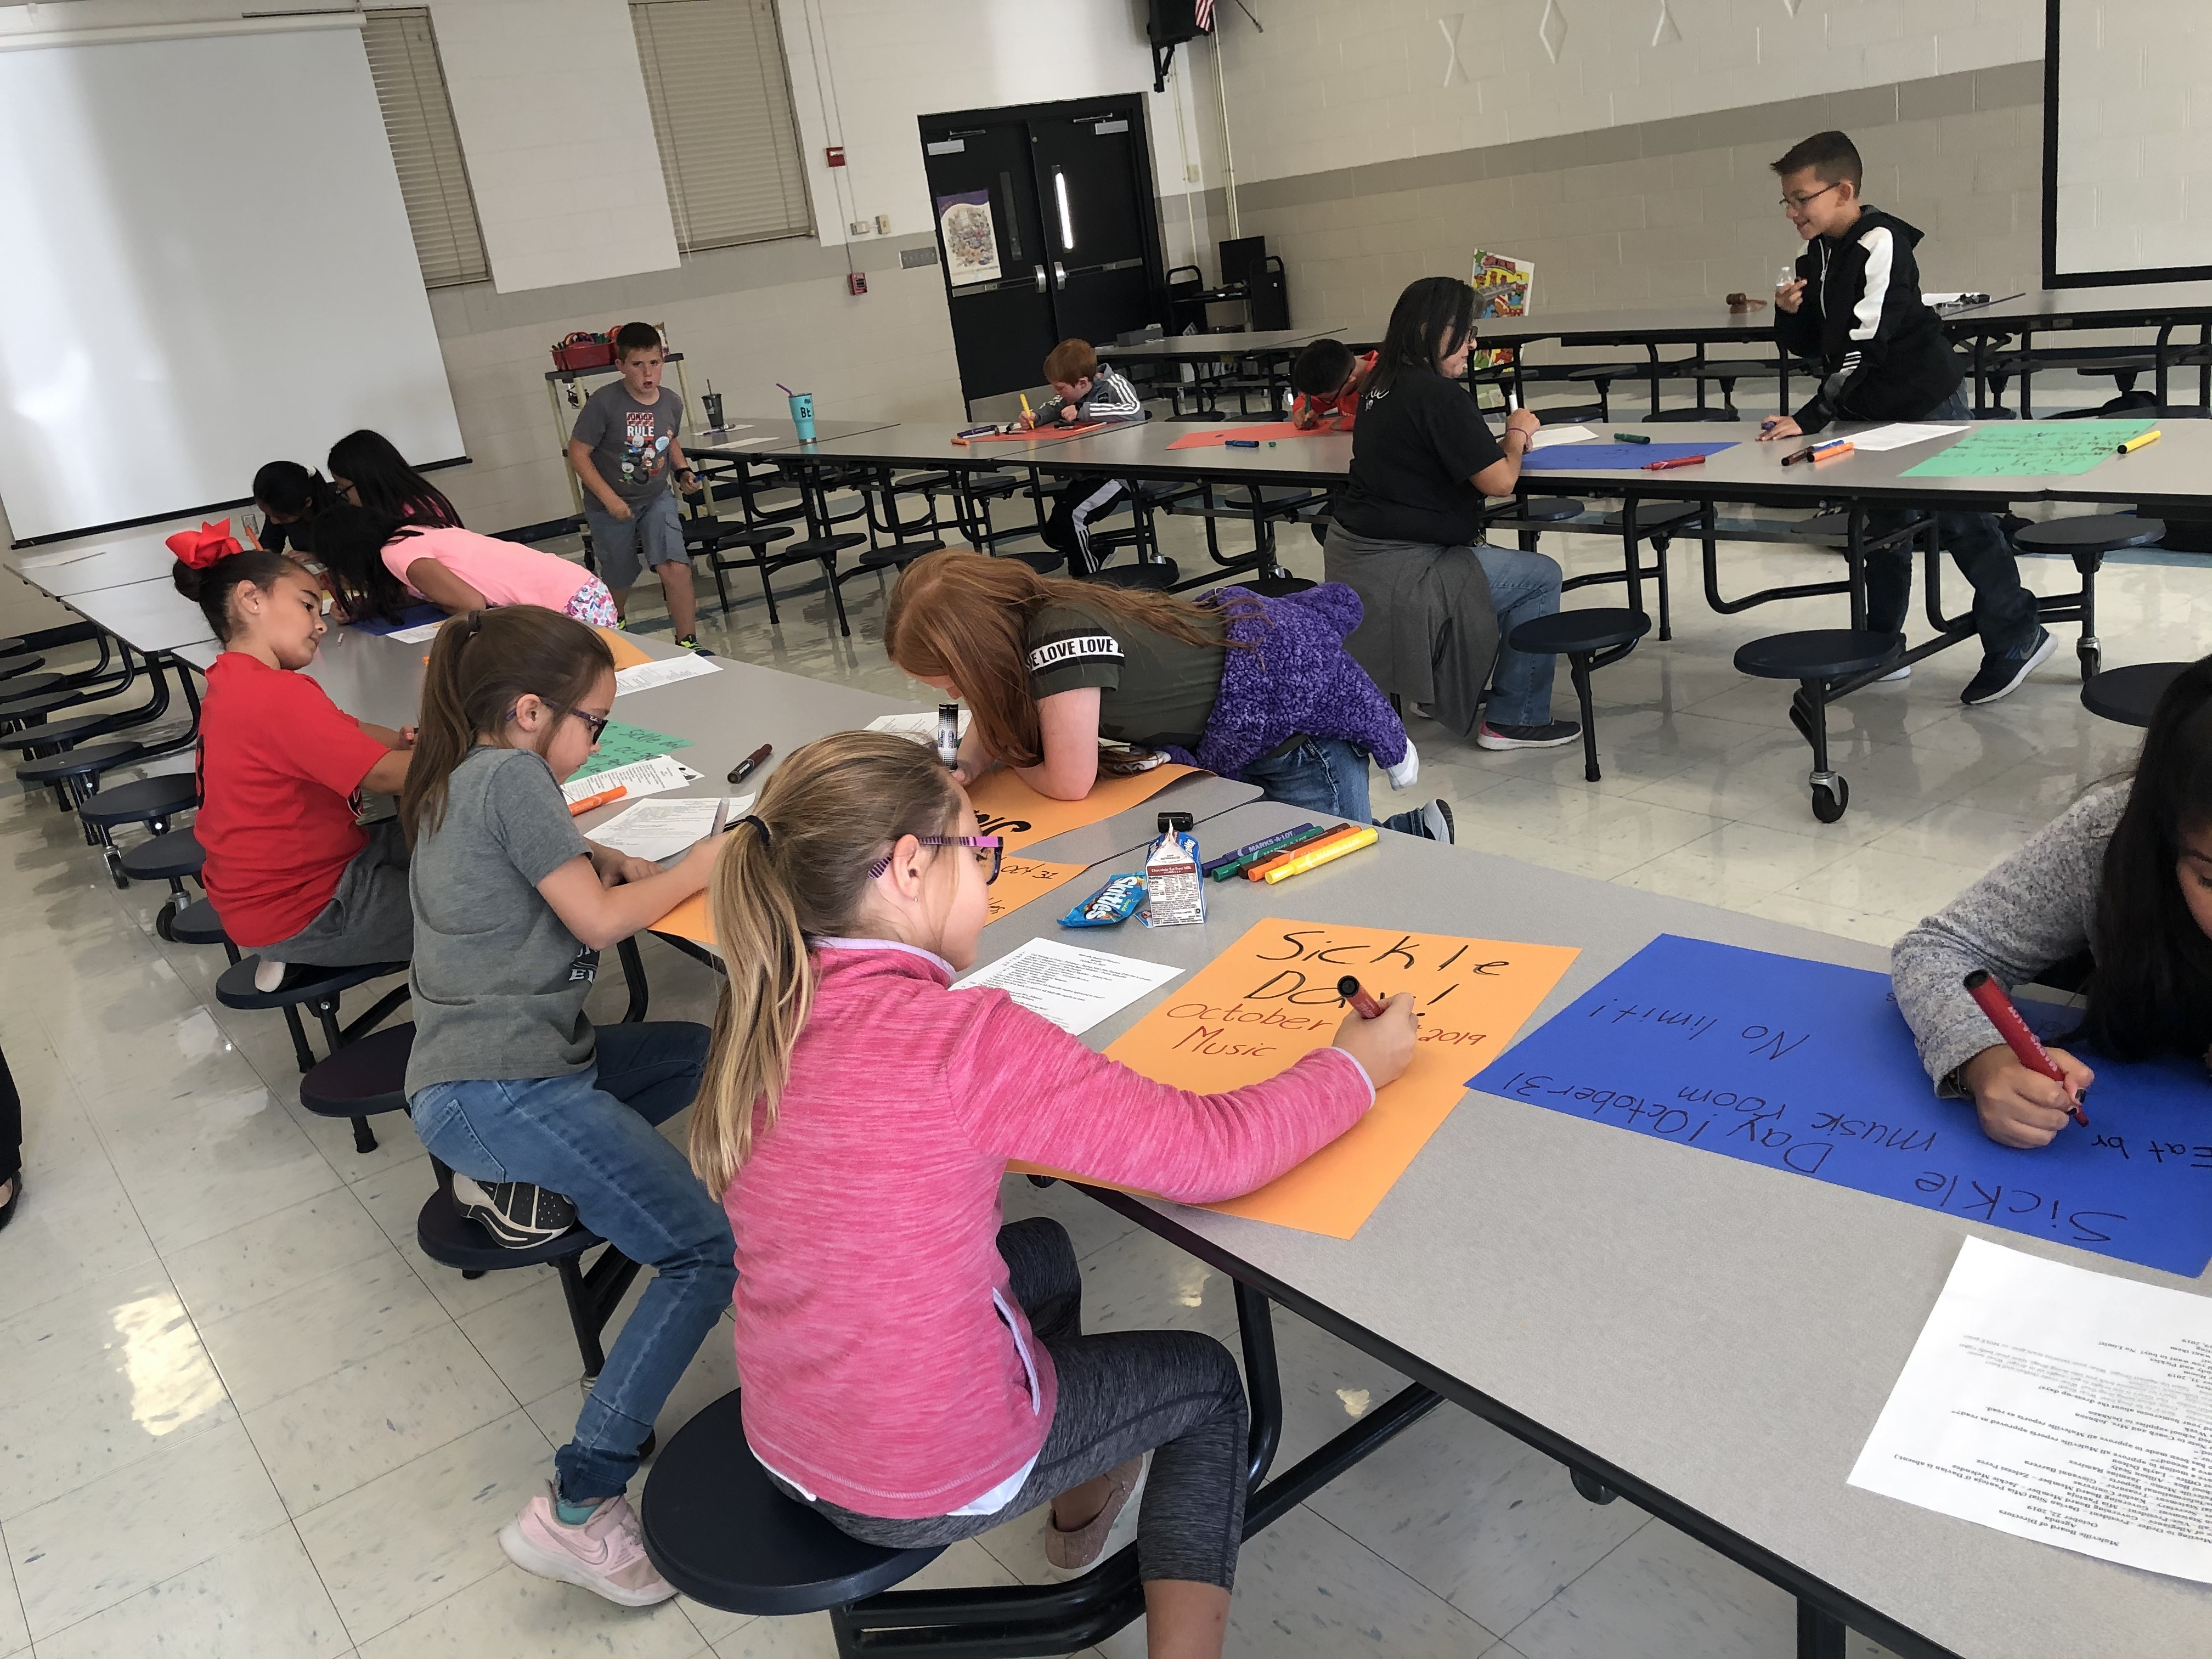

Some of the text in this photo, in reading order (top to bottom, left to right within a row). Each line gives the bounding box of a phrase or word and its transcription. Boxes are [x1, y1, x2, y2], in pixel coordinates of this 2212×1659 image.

[627, 426, 654, 437] RULE
[1039, 641, 1076, 663] LOVE
[1079, 639, 1113, 653] LOVE
[1086, 876, 1138, 919] Skittles
[1256, 930, 1510, 977] Sickle
[1166, 1002, 1487, 1046] October 2019
[1589, 998, 1810, 1061] No limit!
[1172, 1025, 1277, 1058] Music
[1551, 1086, 1689, 1135] October
[2091, 1135, 2130, 1160] br
[1915, 1170, 2129, 1242] Sickle
[2149, 1357, 2177, 1367] Pickles
[2182, 1370, 2207, 1379] Room
[2061, 1390, 2095, 1403] dress-up
[2017, 1414, 2046, 1425] reports
[2074, 1412, 2108, 1424] Johnson
[2136, 1409, 2180, 1424] homeroom
[1989, 1419, 2028, 1432] approved
[2047, 1423, 2085, 1437] Muleville
[2135, 1421, 2168, 1432] supplies
[2184, 1426, 2207, 1437] Week
[2029, 1430, 2058, 1441] reports
[2148, 1430, 2175, 1441] Coach
[2169, 1430, 2196, 1439] school
[2060, 1439, 2098, 1453] Muleville
[2099, 1436, 2133, 1448] approve
[2187, 1440, 2207, 1449] Note
[2112, 1452, 2147, 1465] approve
[2145, 1448, 2168, 1457] made
[2169, 1454, 2190, 1464] been
[2024, 1460, 2056, 1473] Barrera
[2068, 1459, 2103, 1474] Ramirez
[2159, 1465, 2188, 1476] motion
[2191, 1460, 2205, 1469] has
[1934, 1465, 1963, 1478] Davian
[1973, 1477, 2005, 1491] Pantoja
[1991, 1476, 2018, 1488] Jackie
[2038, 1477, 2074, 1491] Member
[2108, 1477, 2142, 1490] Reports
[2149, 1482, 2177, 1493] Memo
[2173, 1482, 2190, 1490] Box
[2175, 1476, 2202, 1487] Office
[2027, 1487, 2063, 1501] Member
[2066, 1491, 2098, 1504] Pantoja
[2075, 1487, 2102, 1499] Board
[2179, 1489, 2212, 1501] uleville
[2191, 1487, 2211, 1495] hool
[2064, 1497, 2091, 1509] Board
[1998, 1509, 2038, 1525] Directors
[2026, 1505, 2098, 1528] October 22, 2019
[2044, 1515, 2076, 1528] Agenda
[2050, 1524, 2077, 1536] Board
[2136, 1523, 2164, 1533] Order
[2079, 1532, 2119, 1547] Muleville
